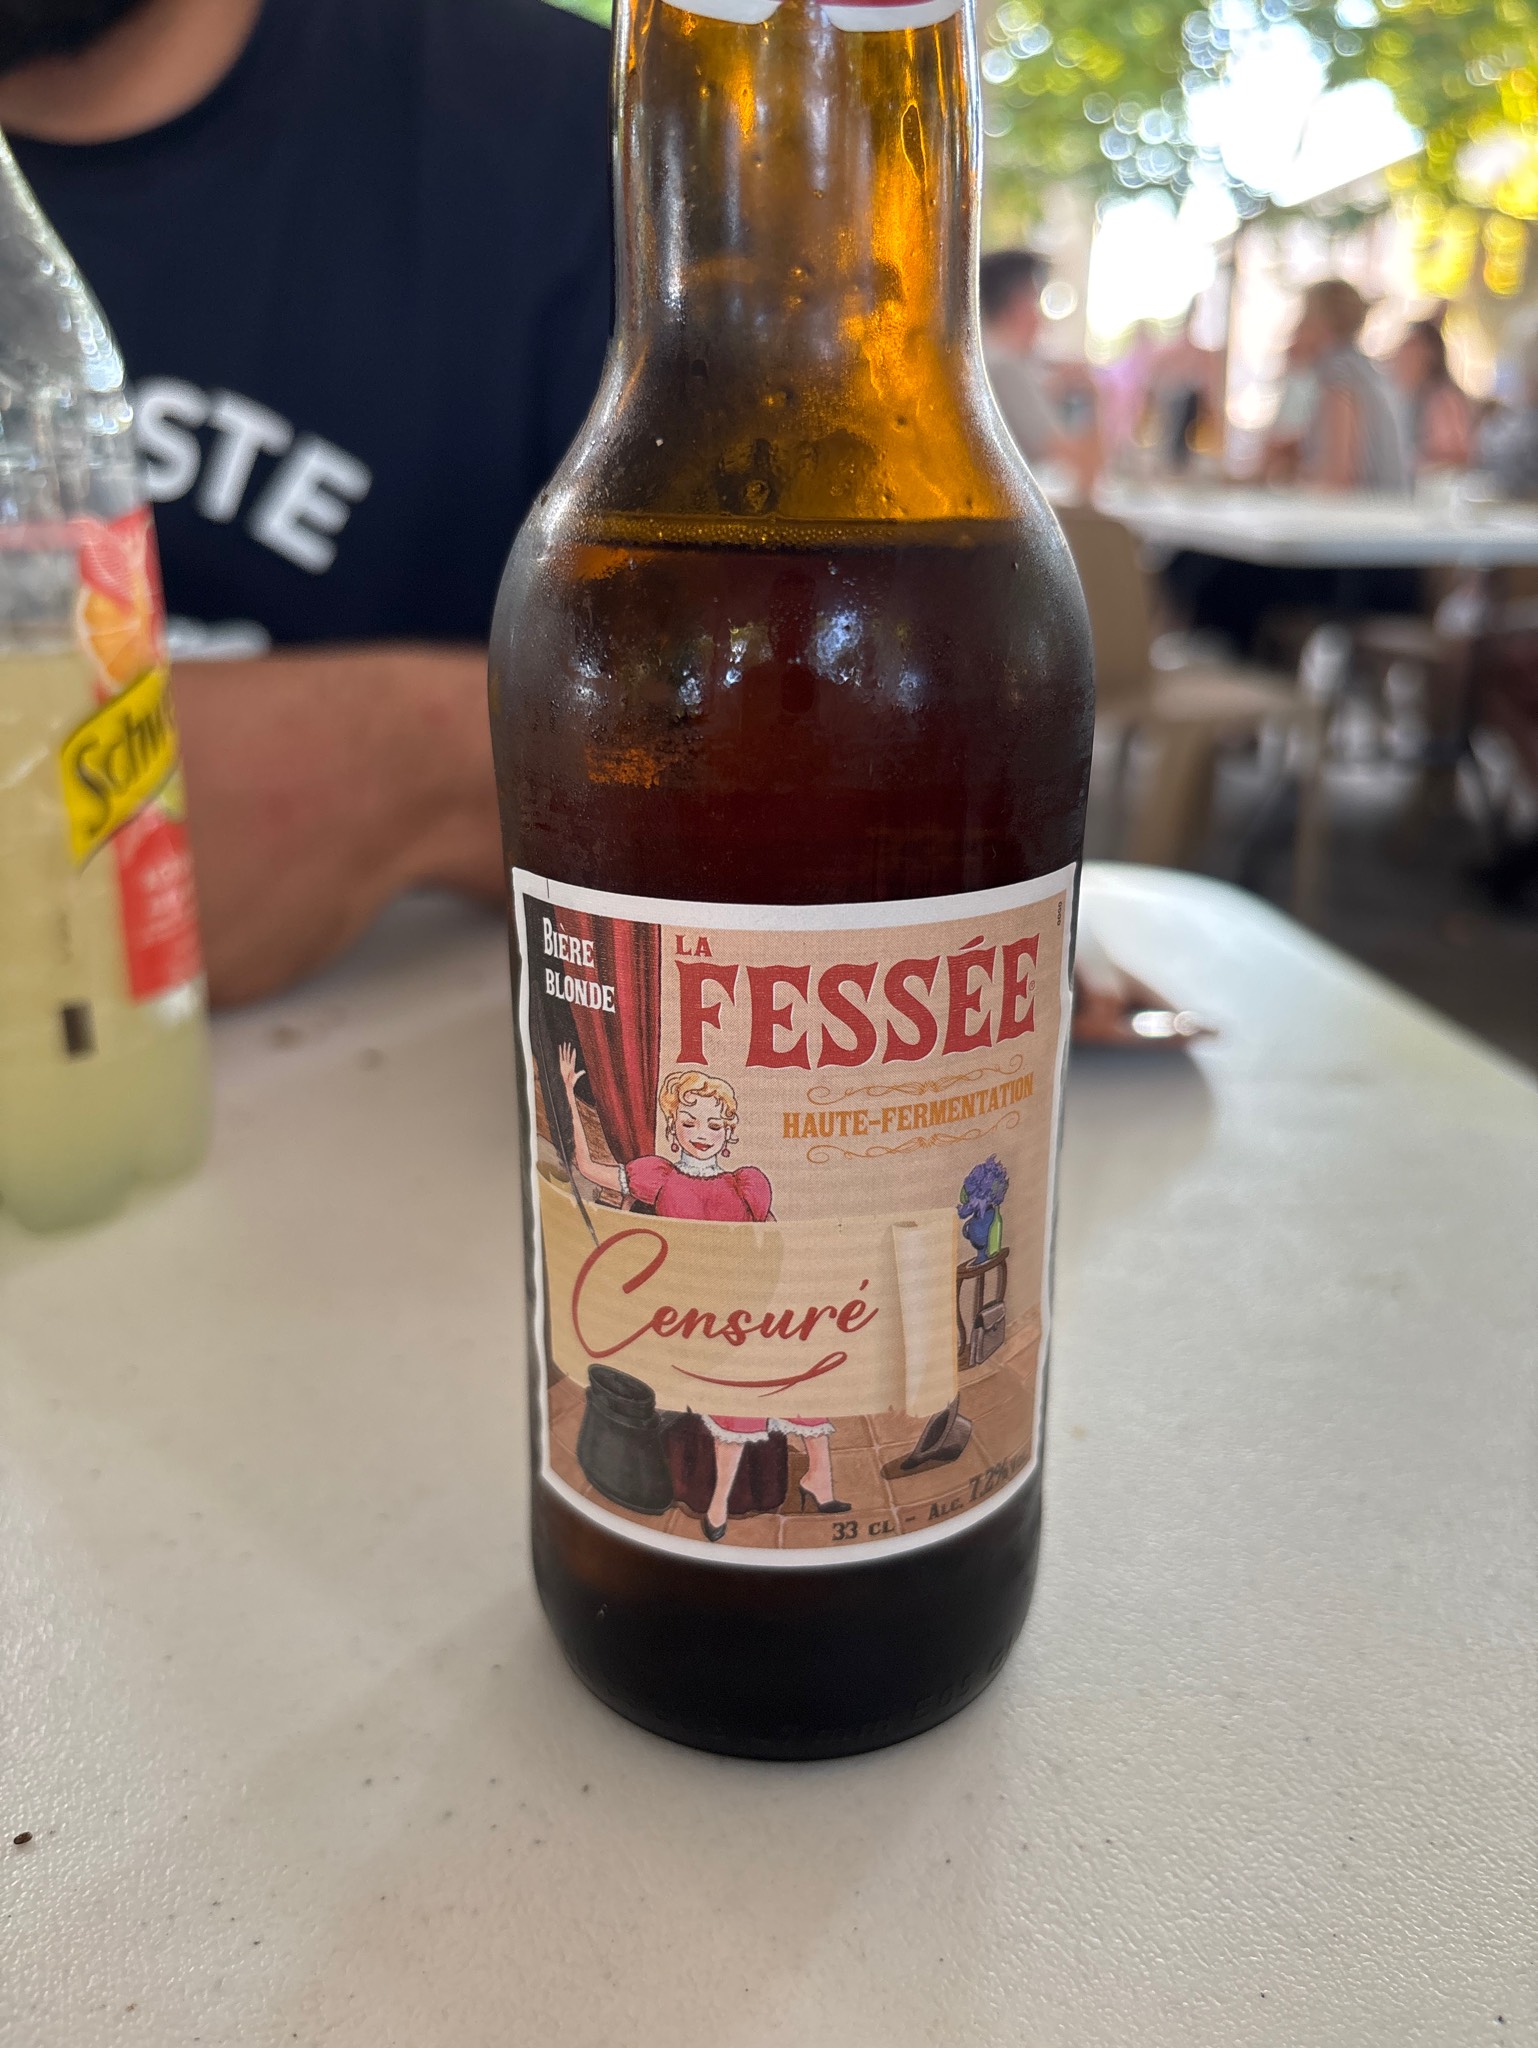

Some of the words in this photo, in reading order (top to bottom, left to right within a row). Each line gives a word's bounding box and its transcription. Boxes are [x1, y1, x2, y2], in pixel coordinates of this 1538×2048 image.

[542, 917, 594, 968] BIÈRE
[675, 934, 712, 957] LA
[545, 968, 616, 1014] BLONDE
[674, 933, 1041, 1070] FESSÉE
[782, 1072, 1034, 1139] HAUTE-FERMENTATION
[572, 1228, 878, 1358] Censuré
[831, 1520, 858, 1541] 33
